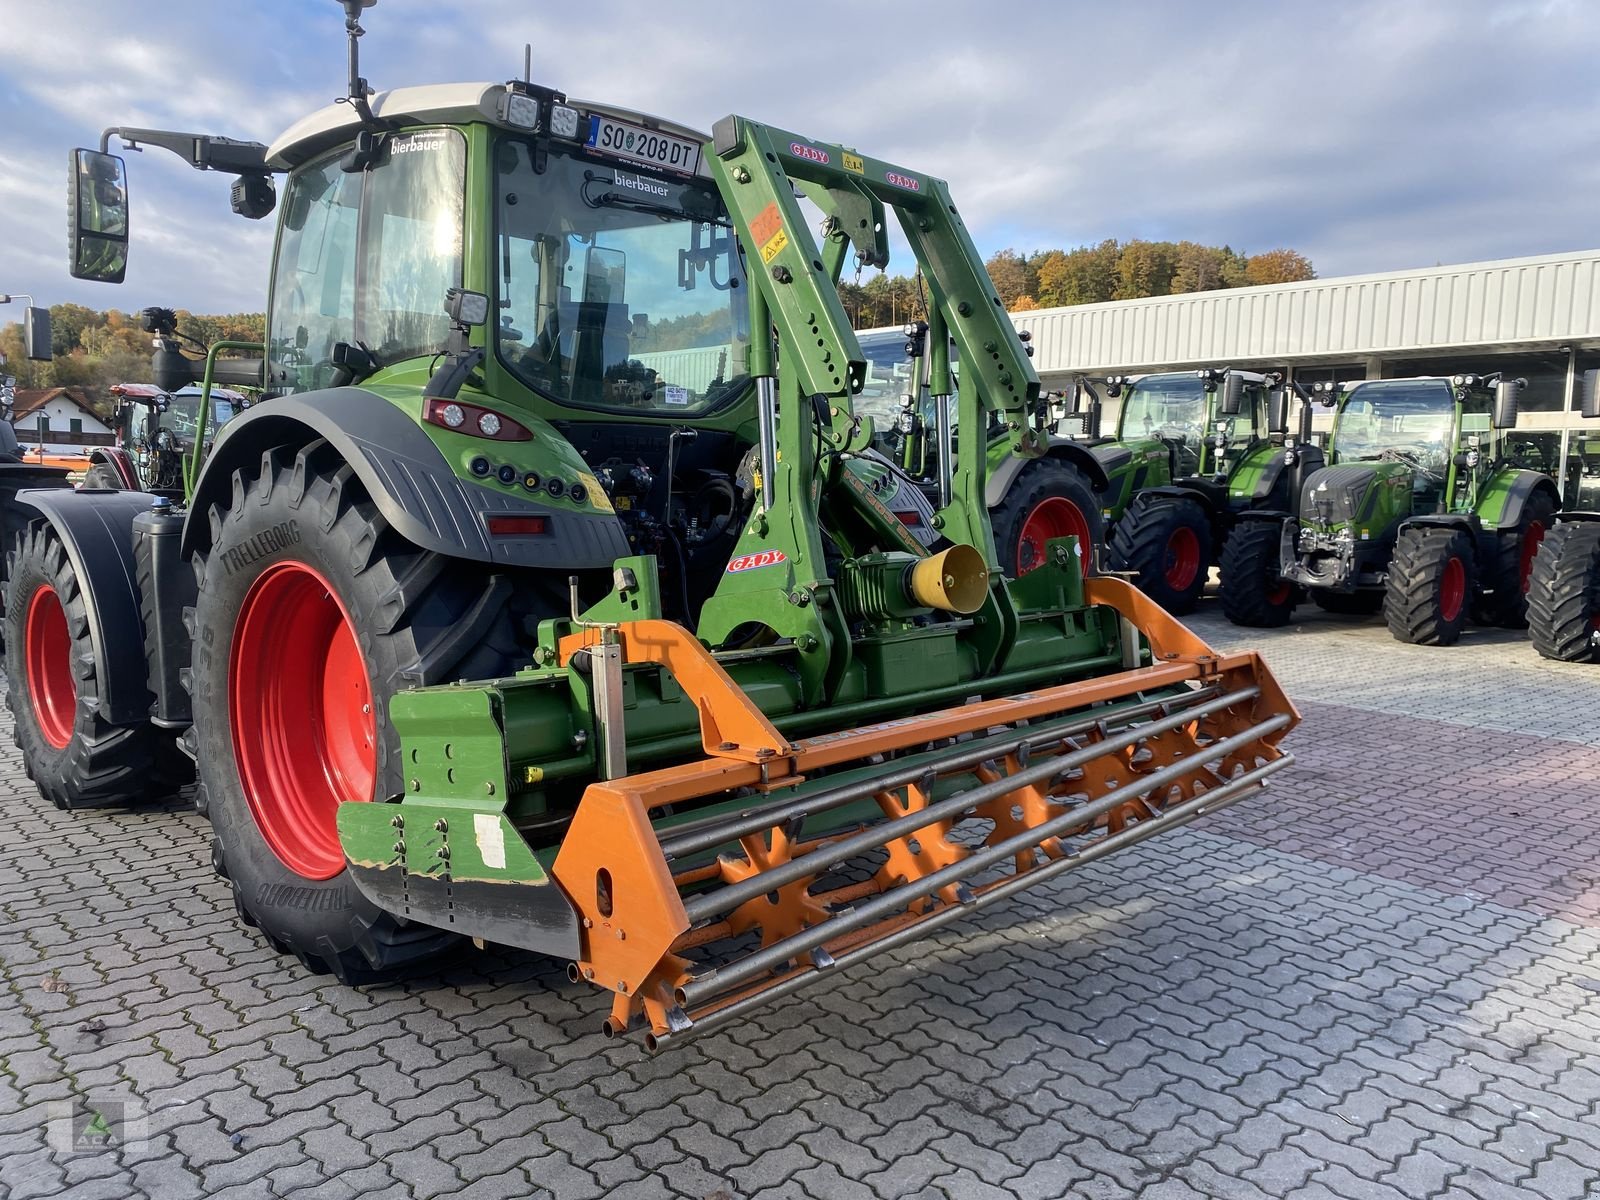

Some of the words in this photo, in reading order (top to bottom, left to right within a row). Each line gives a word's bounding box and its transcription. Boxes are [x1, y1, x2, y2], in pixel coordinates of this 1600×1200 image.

[391, 135, 445, 155] bierbauer
[636, 133, 668, 161] 208
[670, 142, 692, 167] DT
[794, 144, 826, 163] GADY
[614, 169, 668, 197] bierbauer
[889, 173, 917, 190] GADY
[219, 518, 301, 576] TRELLEBORG
[732, 551, 782, 571] GADY
